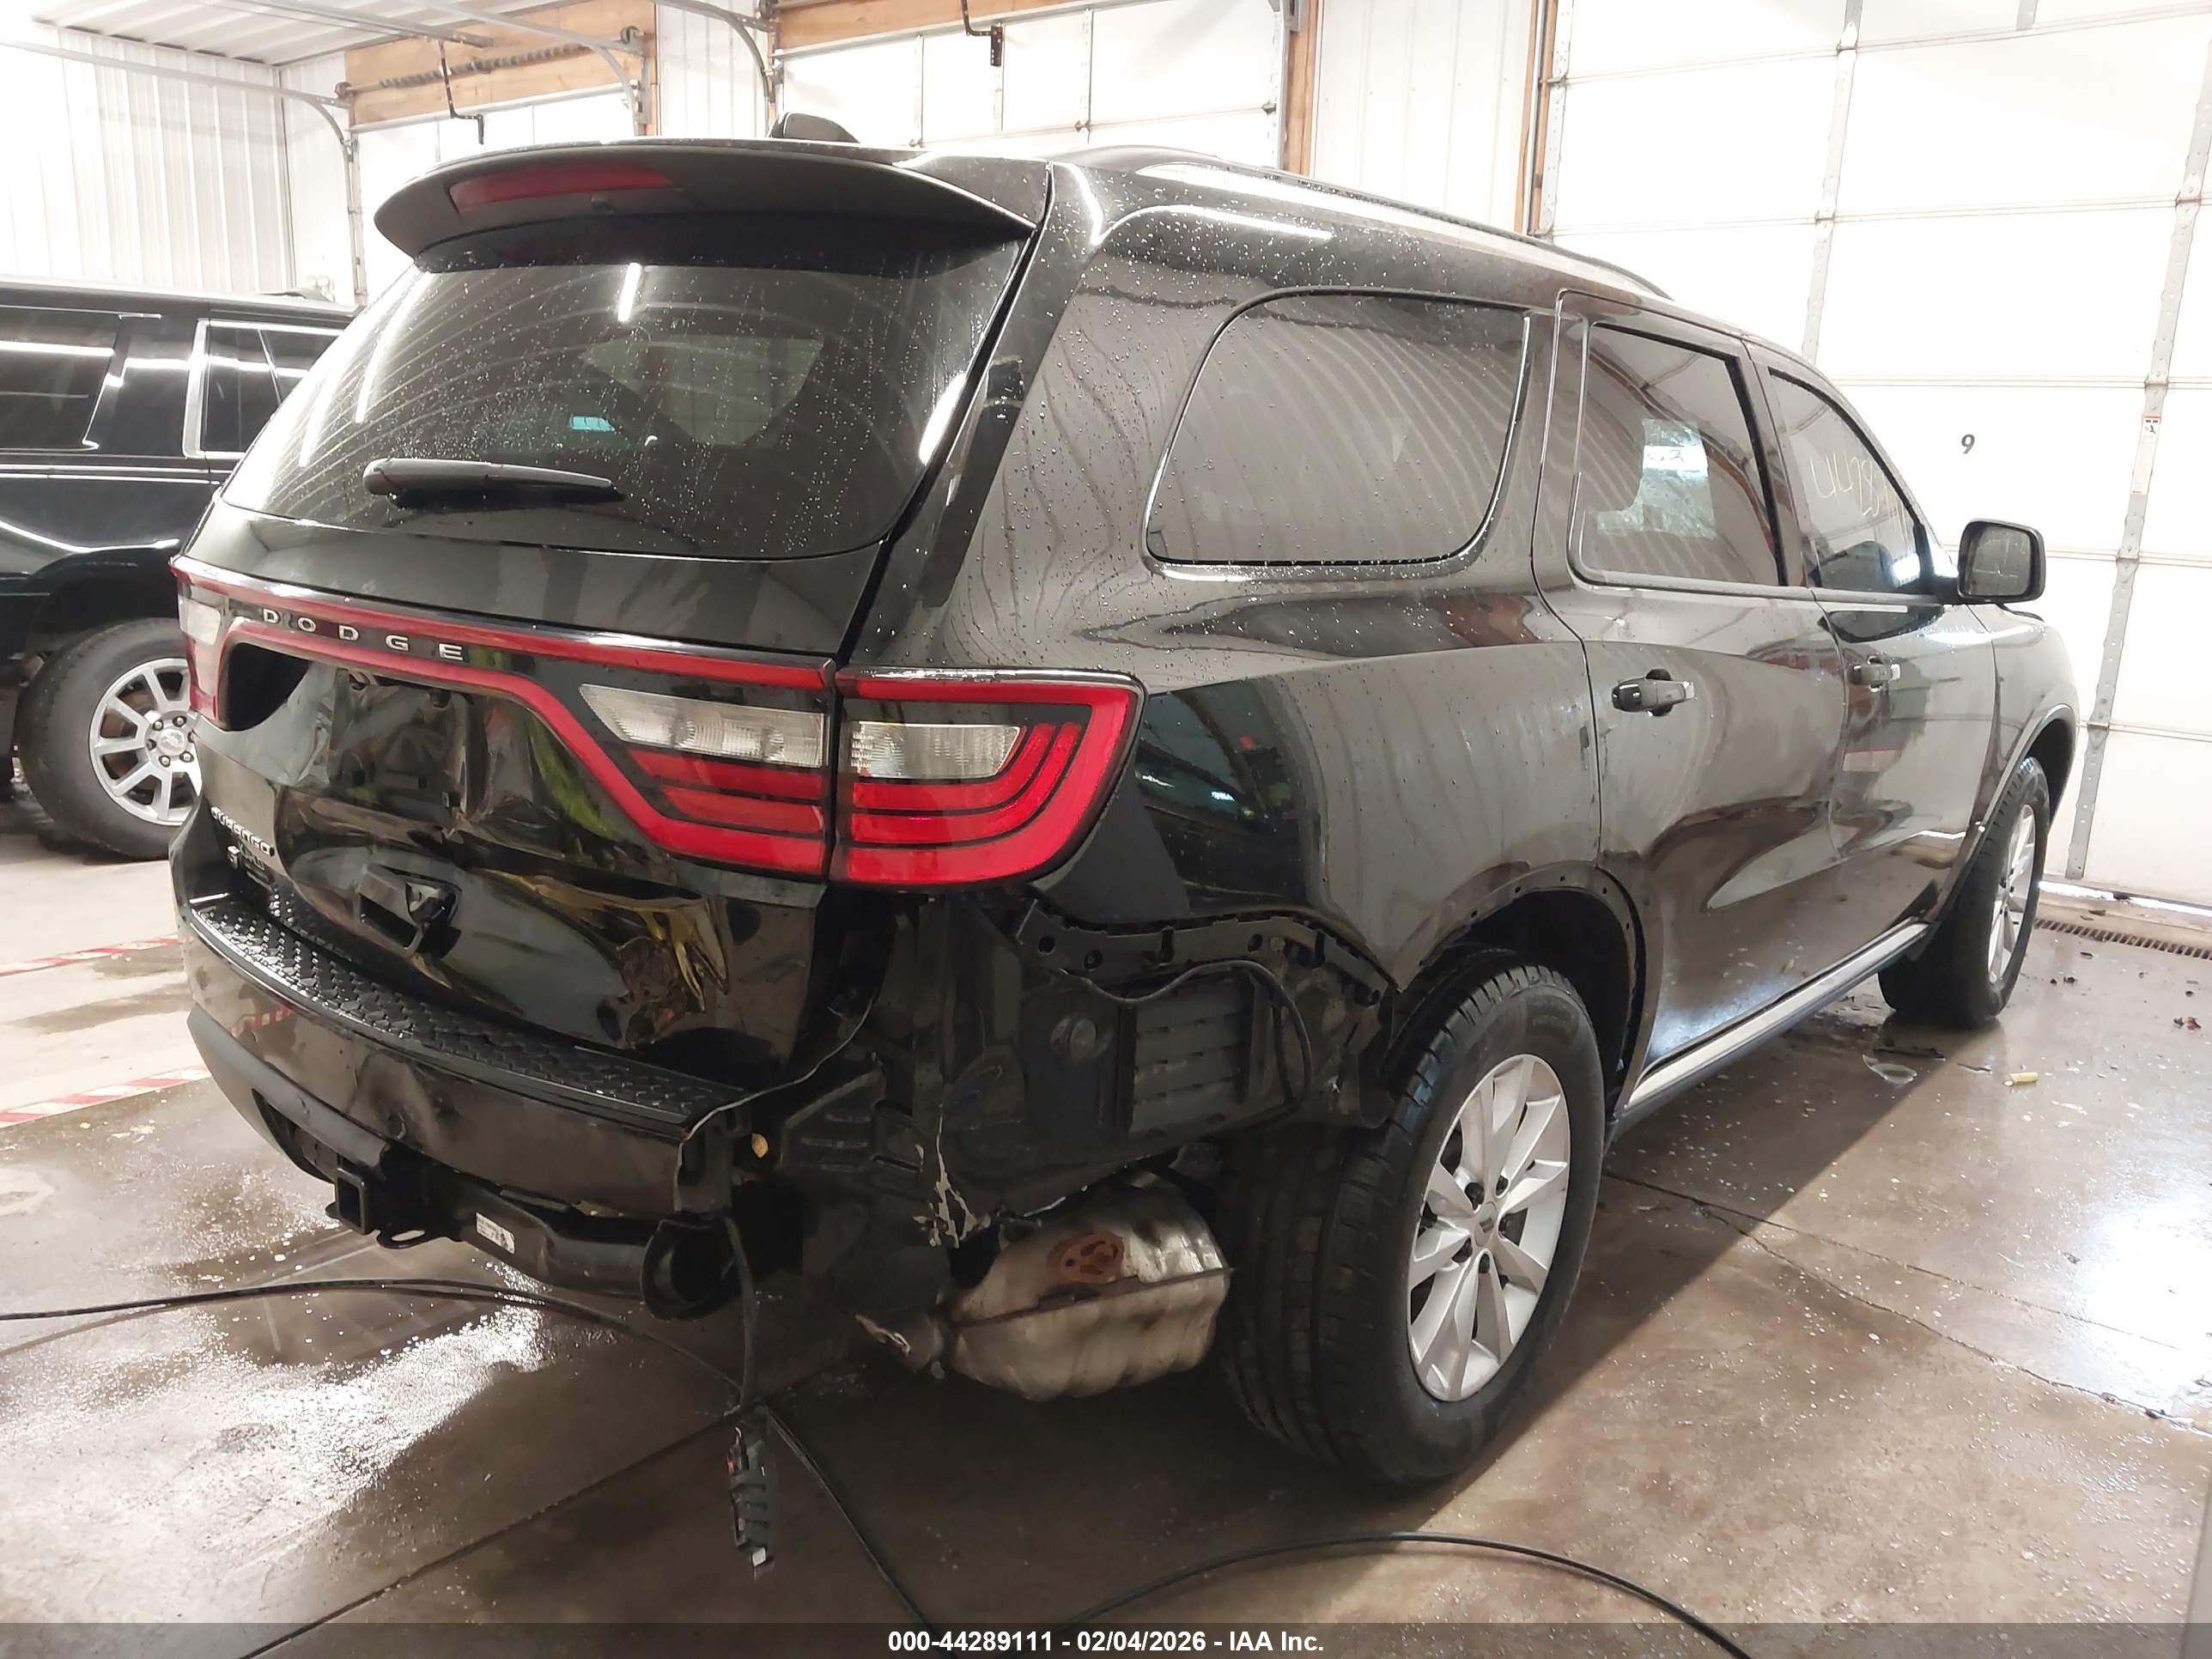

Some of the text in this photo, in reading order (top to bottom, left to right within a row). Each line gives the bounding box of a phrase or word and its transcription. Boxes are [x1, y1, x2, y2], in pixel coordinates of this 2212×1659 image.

[1961, 434, 1975, 453] 9
[263, 608, 464, 661] DODGE
[210, 806, 275, 857] DURANGO
